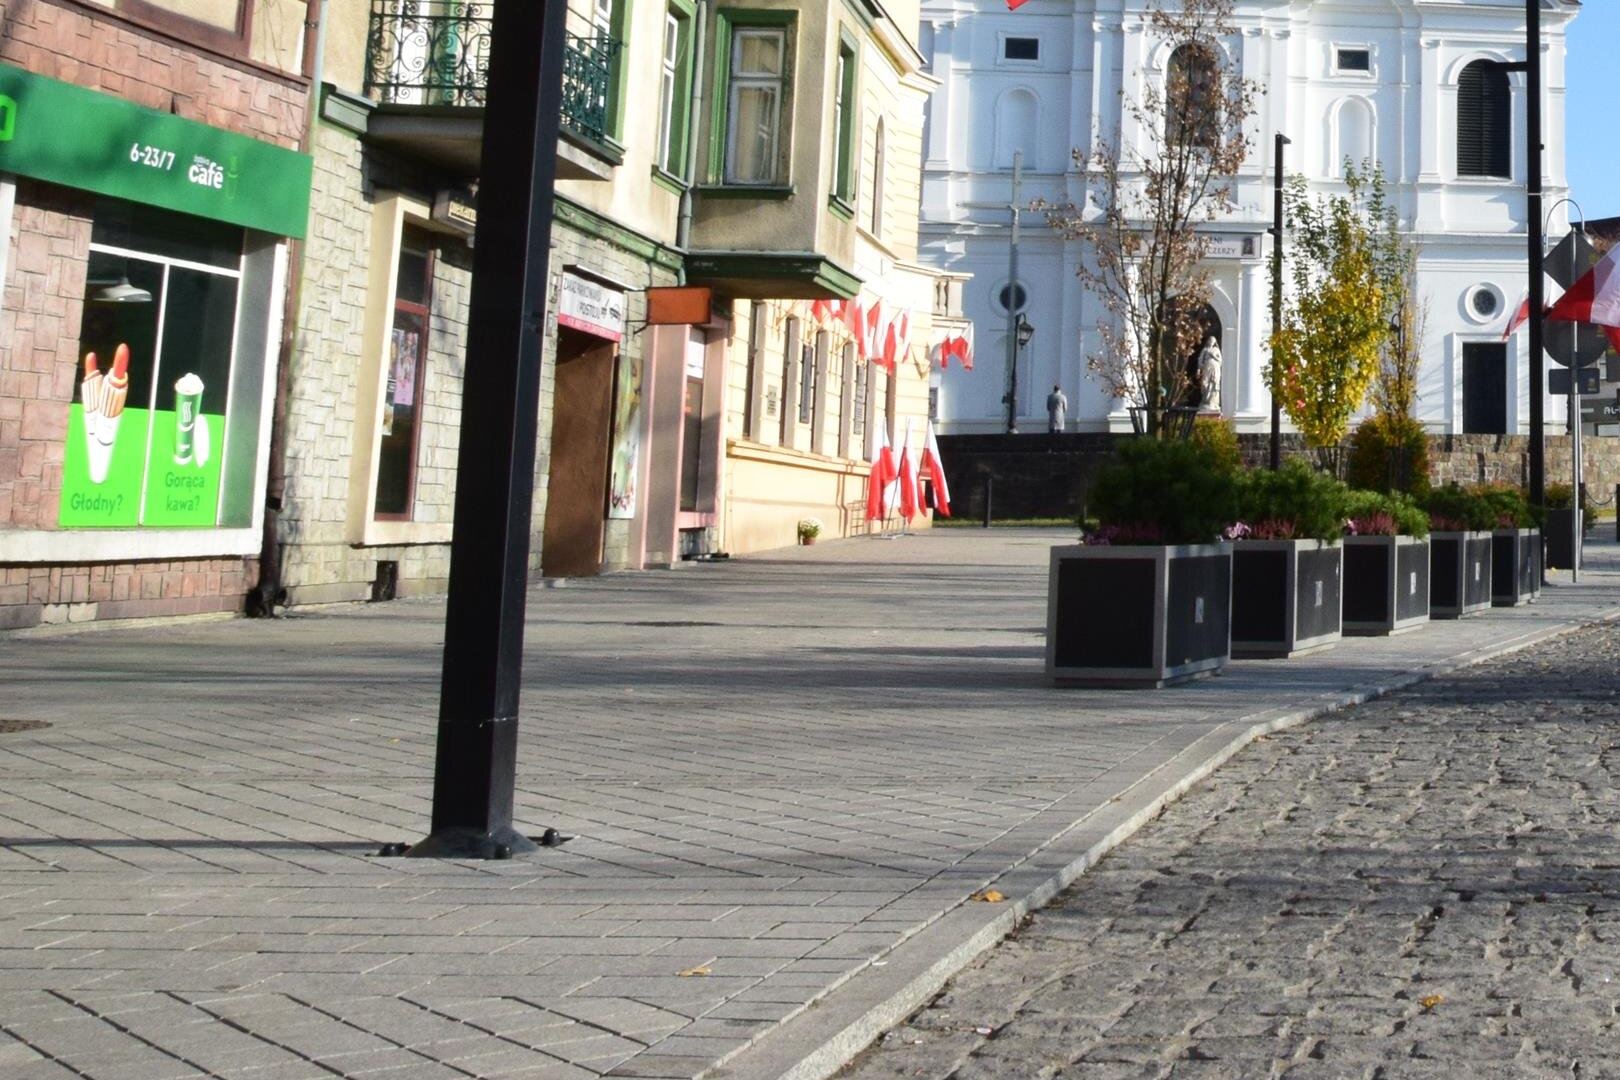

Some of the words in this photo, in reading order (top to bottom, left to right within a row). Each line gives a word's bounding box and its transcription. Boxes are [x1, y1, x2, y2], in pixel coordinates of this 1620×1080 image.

[130, 143, 176, 171] 6-23/7
[188, 162, 224, 189] café
[165, 472, 205, 492] Gorąca
[70, 493, 123, 516] Głodny?
[166, 495, 200, 511] kawa?
